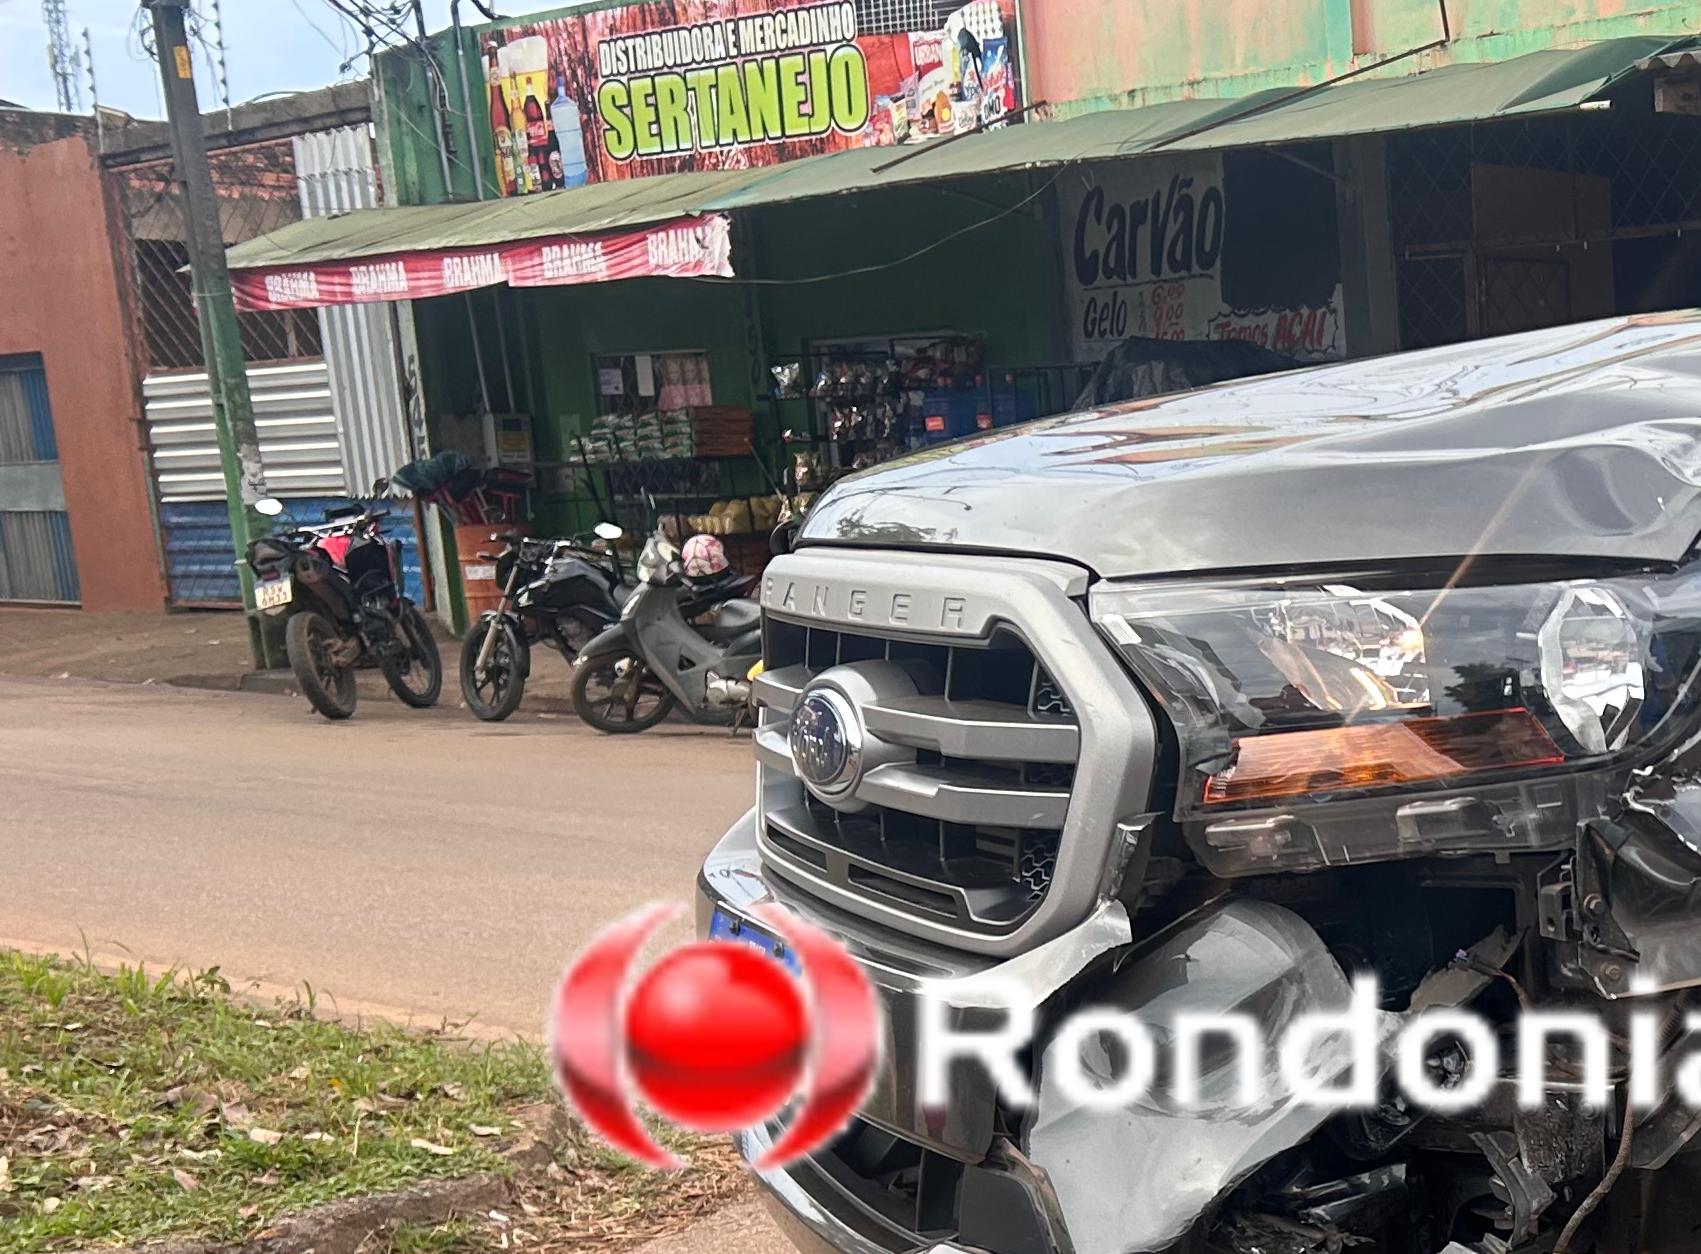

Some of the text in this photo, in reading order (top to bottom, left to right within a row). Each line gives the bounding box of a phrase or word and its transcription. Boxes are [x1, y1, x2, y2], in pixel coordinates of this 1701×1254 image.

[599, 3, 856, 77] DISTRIBUIDORA E MERCADINHO
[598, 43, 869, 160] SERTANEJO
[1074, 174, 1226, 286] Carvão
[350, 261, 408, 294] BRAHMA
[443, 252, 508, 288] BRAHMA
[1083, 290, 1128, 339] Gelo
